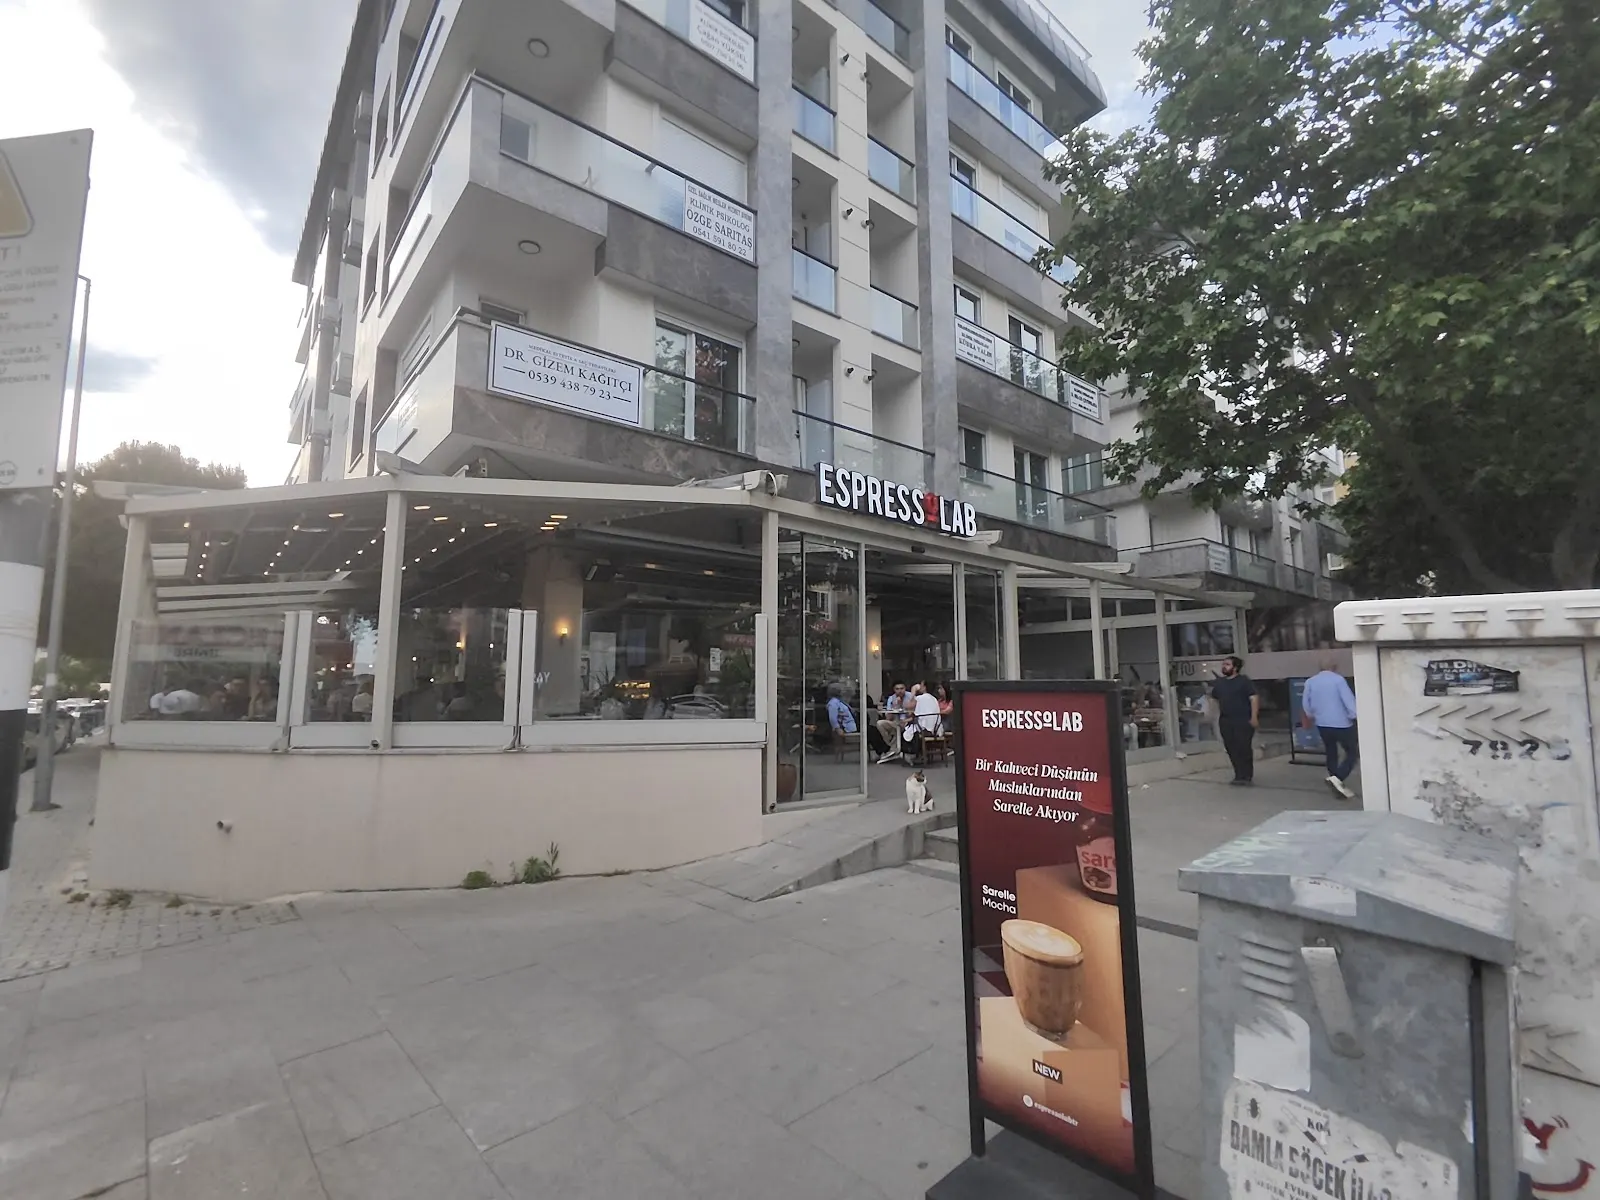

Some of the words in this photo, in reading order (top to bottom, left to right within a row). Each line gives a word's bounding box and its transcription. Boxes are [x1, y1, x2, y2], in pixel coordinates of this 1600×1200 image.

[687, 207, 712, 229] ÖZGE
[715, 221, 753, 250] SARITAŞ
[693, 226, 710, 240] 0541
[716, 210, 750, 233] PSİKOLOG
[504, 346, 528, 364] DR.
[532, 354, 575, 376] GİZEM
[578, 368, 632, 393] KAĞITÇI
[528, 369, 557, 385] 0539
[559, 377, 580, 392] 438
[583, 384, 596, 396] 79
[599, 389, 611, 400] 23
[819, 462, 977, 537] ESPRESSOLAB
[982, 709, 1083, 732] ESPRESSOLAB
[975, 758, 992, 772] Bir
[994, 760, 1039, 777] Kahveci
[1041, 764, 1099, 783] Düşünün
[988, 778, 1083, 802] Musluklarından
[993, 799, 1034, 816] Sarelle
[1035, 804, 1079, 823] Akıyor
[1081, 850, 1116, 868] sar
[982, 884, 1016, 902] Sarelle
[982, 896, 1016, 914] Mocha
[1034, 1062, 1060, 1080] NEW
